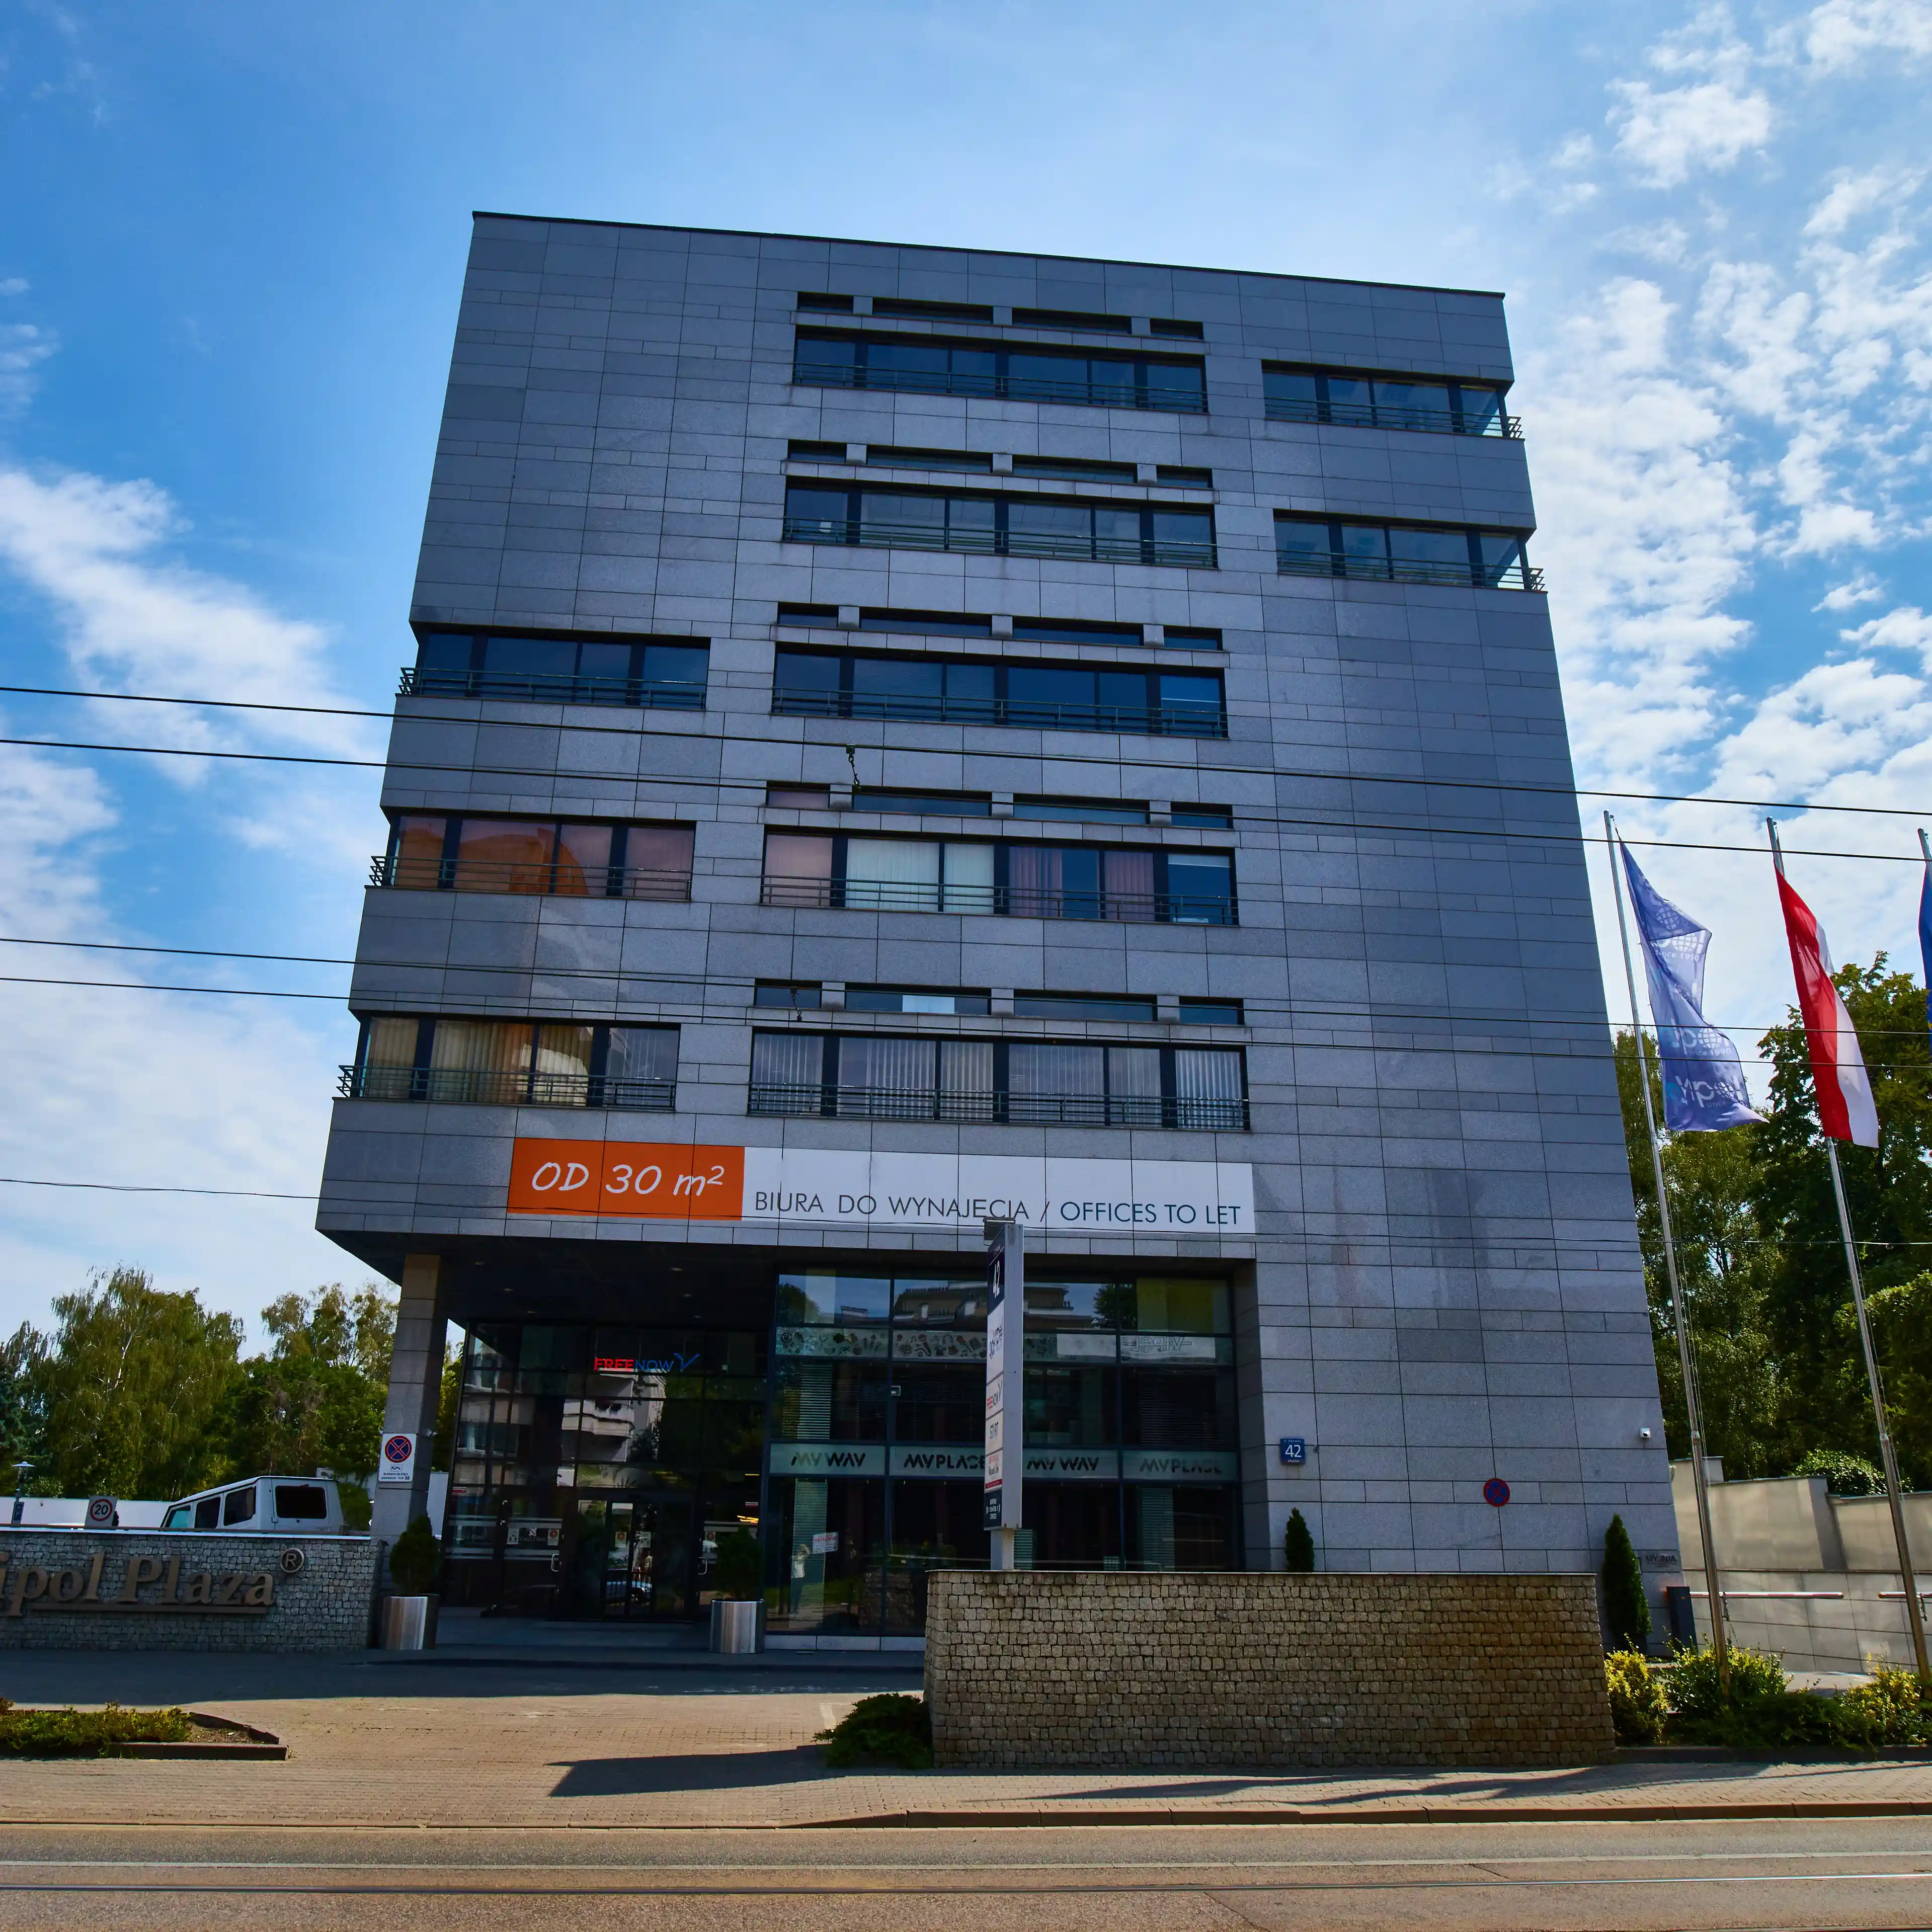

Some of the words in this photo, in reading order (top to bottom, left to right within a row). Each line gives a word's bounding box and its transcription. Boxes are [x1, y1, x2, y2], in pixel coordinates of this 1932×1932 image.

[532, 1162, 589, 1191] OD
[605, 1164, 662, 1195] 30
[755, 1191, 824, 1213] BIURA
[838, 1194, 877, 1215] DO
[1061, 1201, 1157, 1223] OFFICES
[1164, 1204, 1196, 1224] TO
[1205, 1205, 1241, 1225] LET
[993, 1260, 1000, 1298] 42
[1285, 1444, 1302, 1458] 42
[94, 1504, 109, 1515] 20
[112, 1553, 275, 1606] Plaza
